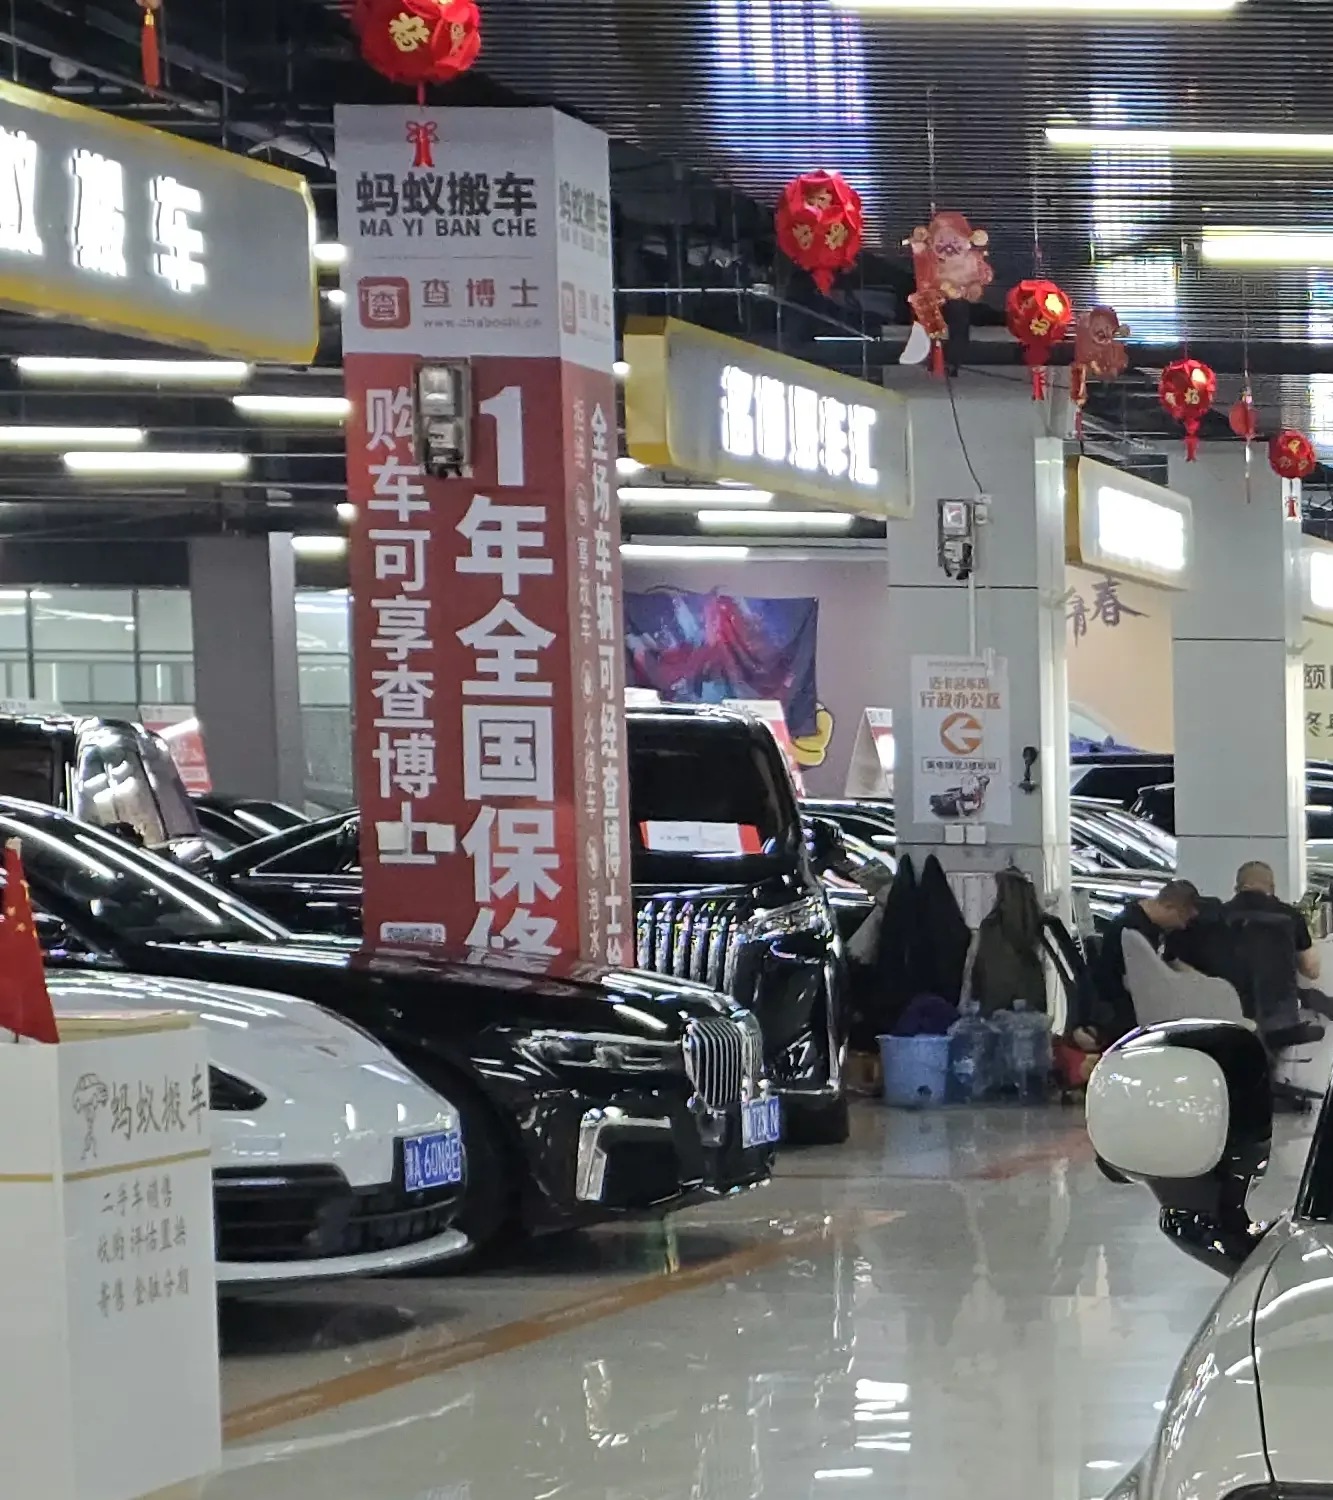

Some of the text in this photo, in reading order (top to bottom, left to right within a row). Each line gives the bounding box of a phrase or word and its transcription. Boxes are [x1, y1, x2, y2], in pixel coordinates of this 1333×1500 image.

[356, 171, 537, 216] 蚂蚁搬车
[360, 219, 538, 237] MA YI BAN CHE
[421, 278, 541, 308] 查博士
[919, 690, 1002, 710] 行政办公区
[109, 1063, 207, 1141] 蚂蚁搬车
